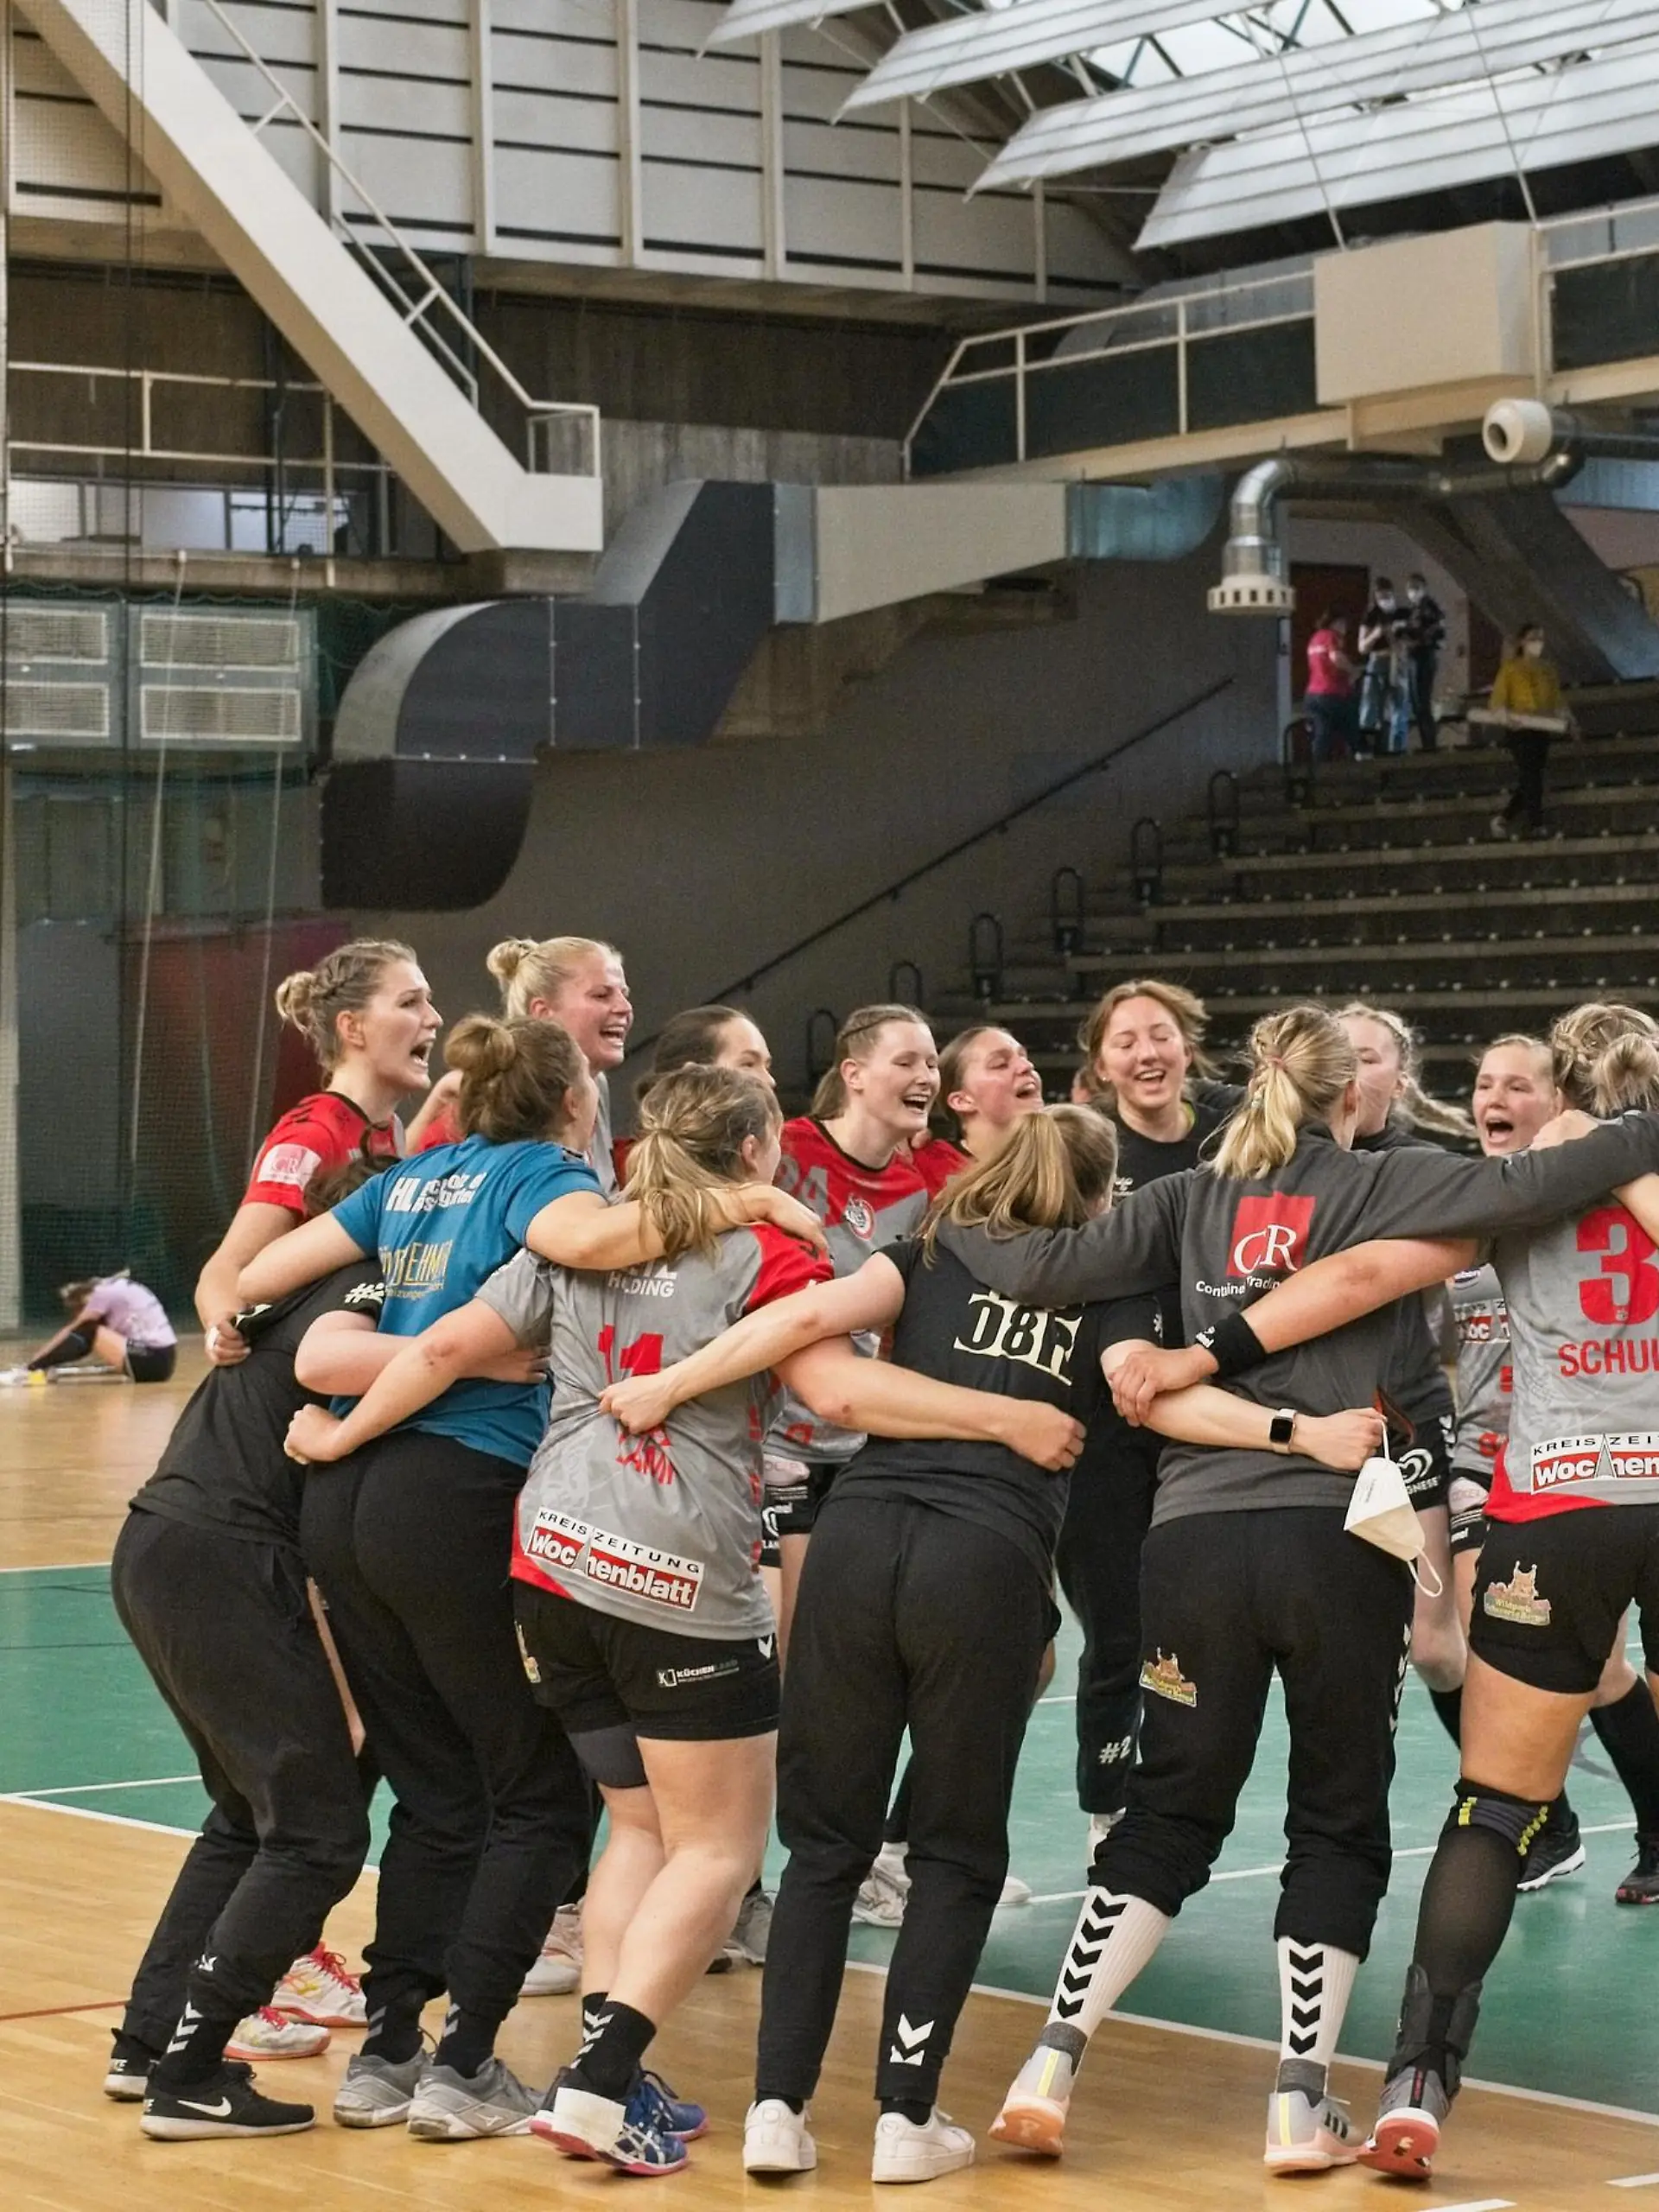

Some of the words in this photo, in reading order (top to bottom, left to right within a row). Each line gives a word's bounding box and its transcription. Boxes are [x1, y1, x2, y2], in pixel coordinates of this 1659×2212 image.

[1234, 1224, 1299, 1274] CR
[1534, 1437, 1596, 1456] KREIS
[1609, 1433, 1659, 1446] ZEI
[538, 1511, 588, 1536] KREIS
[594, 1531, 700, 1574] ZEITUNG
